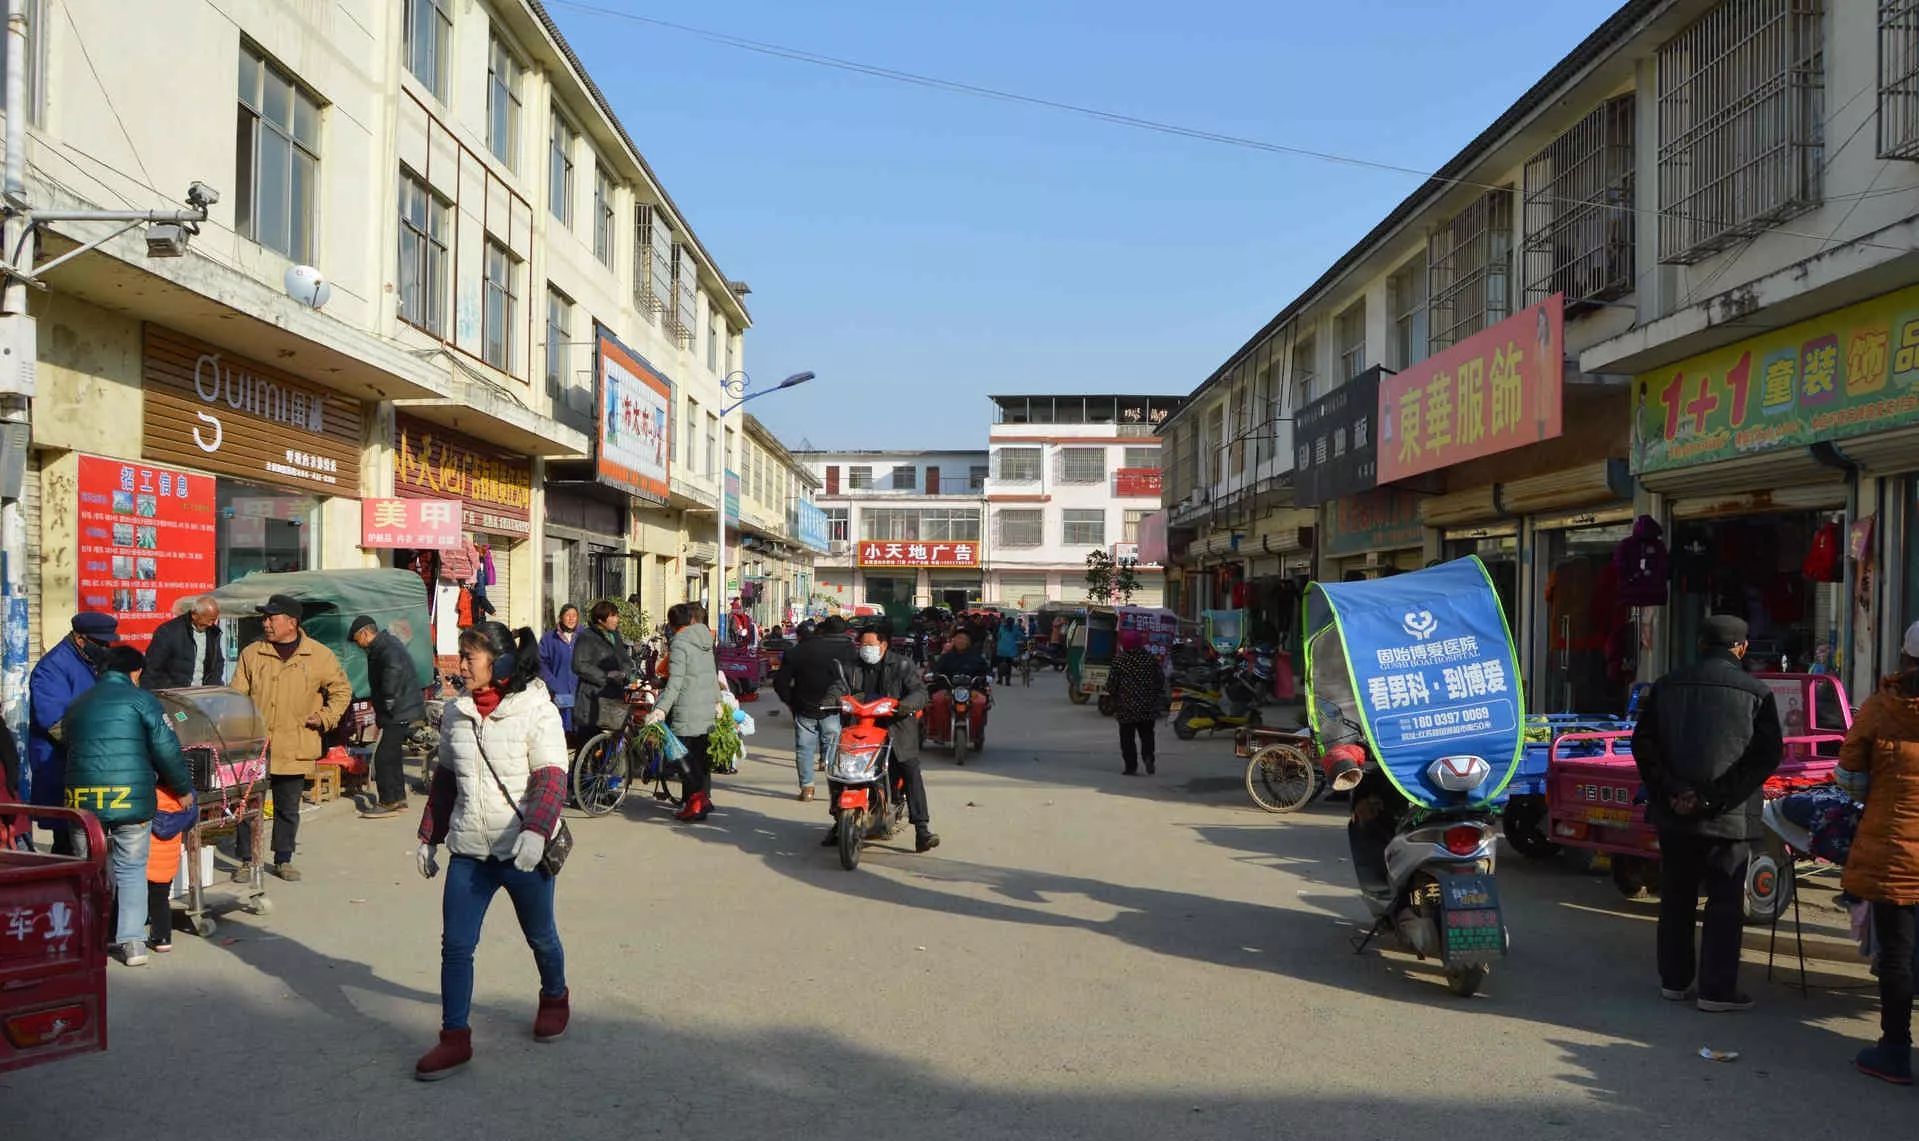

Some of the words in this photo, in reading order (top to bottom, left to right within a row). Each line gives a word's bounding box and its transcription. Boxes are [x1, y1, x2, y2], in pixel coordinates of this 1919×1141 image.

[1398, 340, 1523, 464] 東華服飾
[121, 466, 188, 498] 招工信息
[374, 501, 451, 530] 美甲
[865, 543, 972, 560] 小天地广告
[1376, 635, 1478, 664] 固始博爱医院
